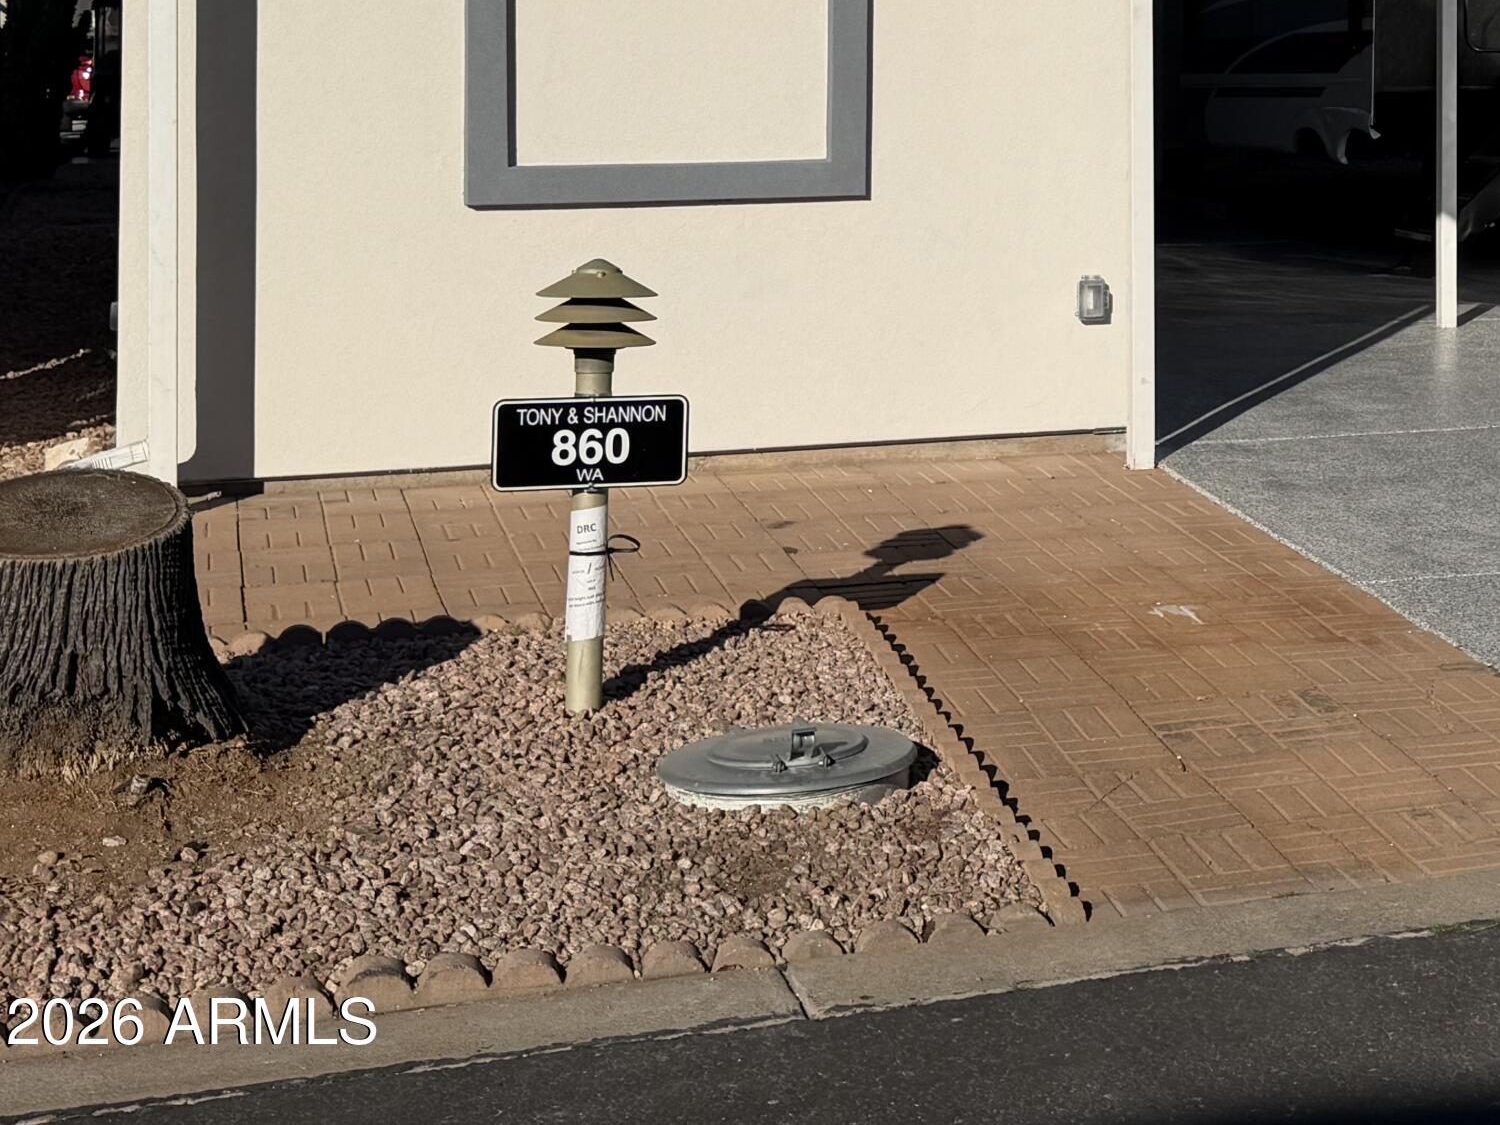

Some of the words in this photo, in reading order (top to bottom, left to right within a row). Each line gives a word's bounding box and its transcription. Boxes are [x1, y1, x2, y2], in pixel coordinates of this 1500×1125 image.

[516, 407, 563, 426] TONY
[567, 406, 579, 424] &
[583, 405, 667, 424] SHANNON
[551, 427, 630, 466] 860
[576, 468, 604, 482] WA
[576, 523, 597, 535] DRC
